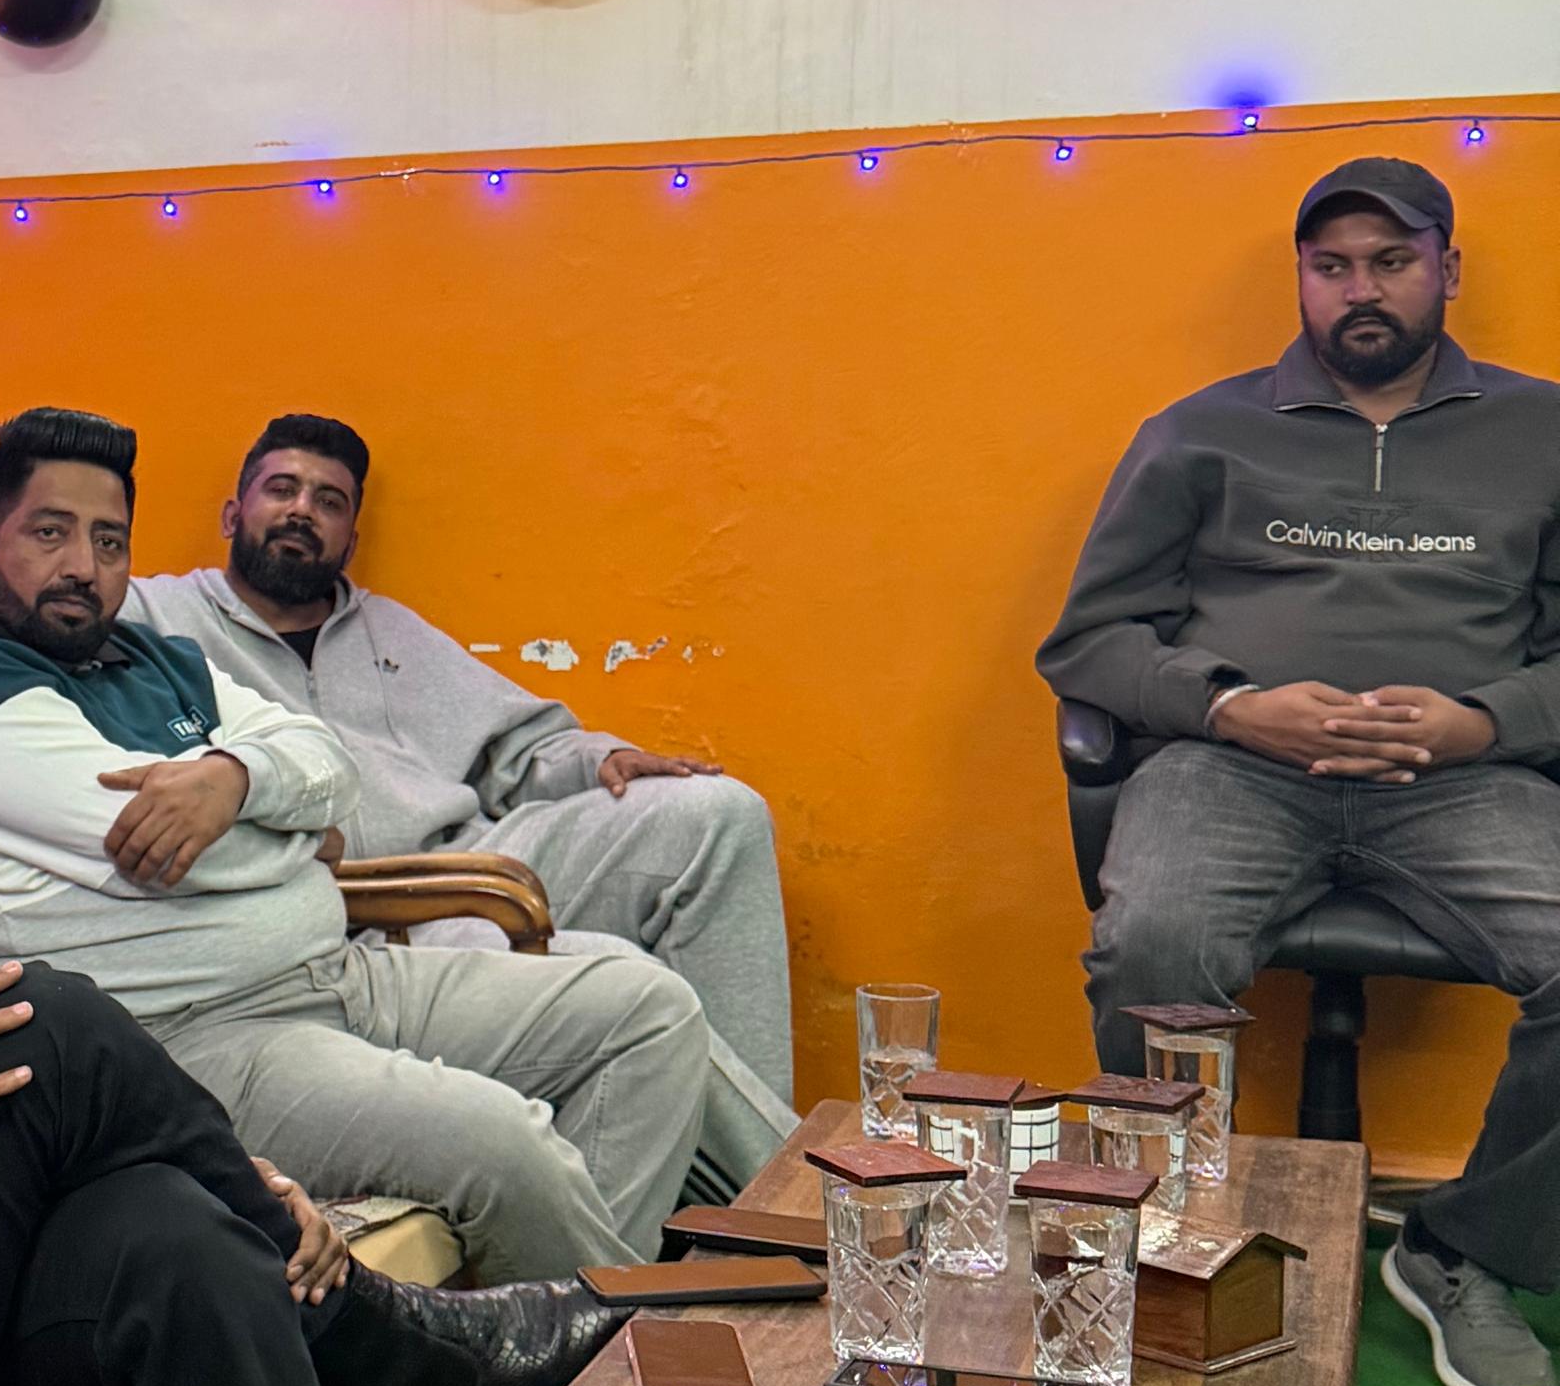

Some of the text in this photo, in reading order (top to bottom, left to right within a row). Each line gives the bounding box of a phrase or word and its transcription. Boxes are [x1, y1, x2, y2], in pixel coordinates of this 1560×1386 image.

[1265, 519, 1477, 552] Calvin Klein Jeans
